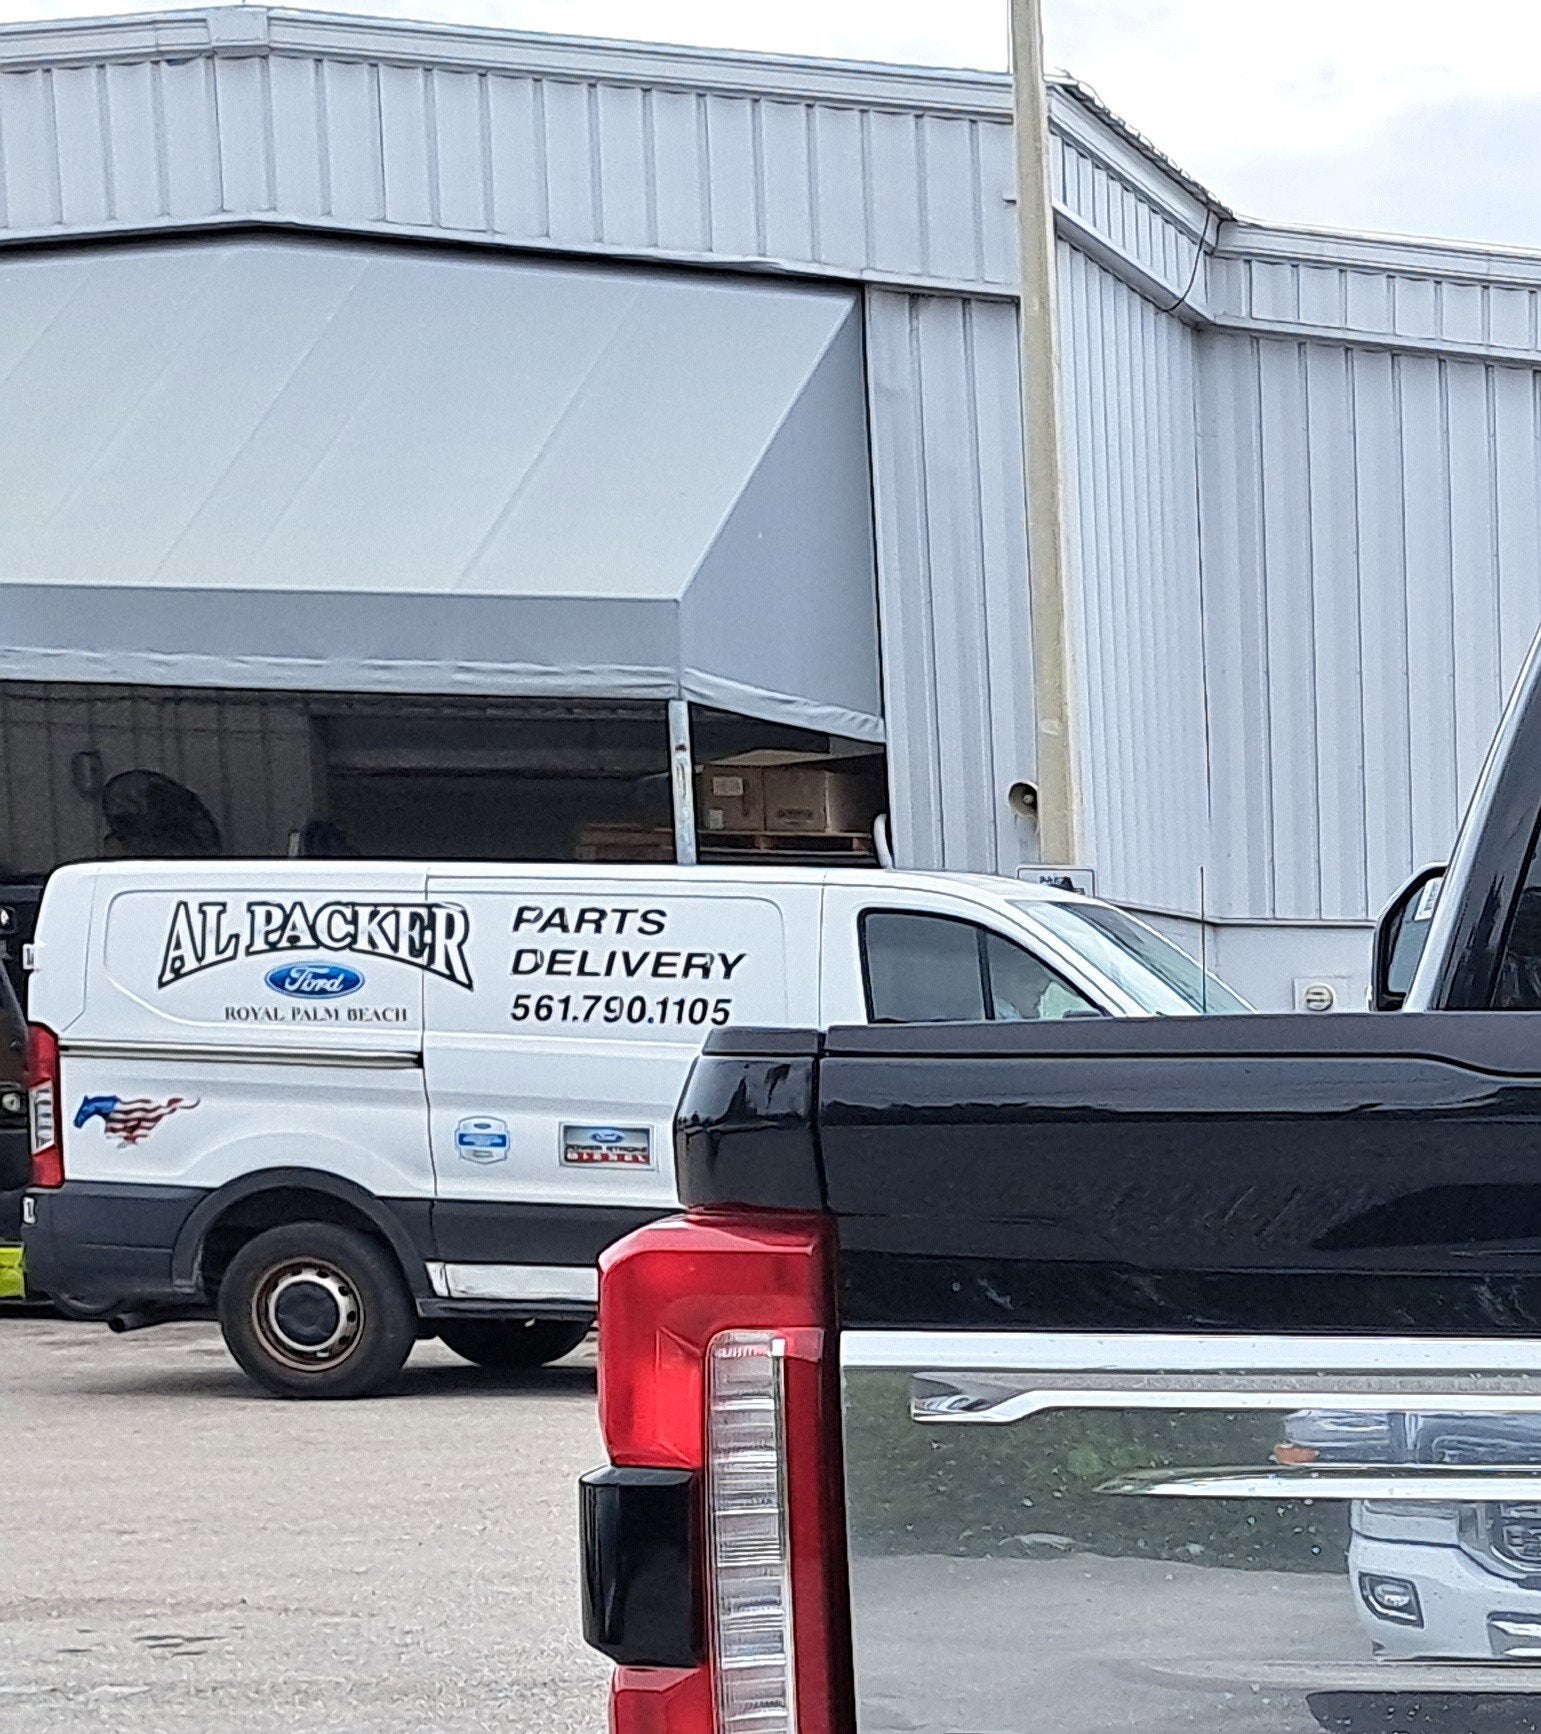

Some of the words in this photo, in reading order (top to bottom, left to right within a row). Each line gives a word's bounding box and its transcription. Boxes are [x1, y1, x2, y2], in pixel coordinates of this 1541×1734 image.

[512, 905, 668, 936] PARTS
[158, 900, 240, 989] AL
[245, 900, 474, 992] PACKER
[284, 966, 345, 992] Ford
[510, 948, 747, 980] DELIVERY
[225, 1006, 286, 1021] ROYAL
[291, 1007, 340, 1021] PALM
[348, 1007, 407, 1022] BEACH
[510, 994, 733, 1026] 561.790.1105
